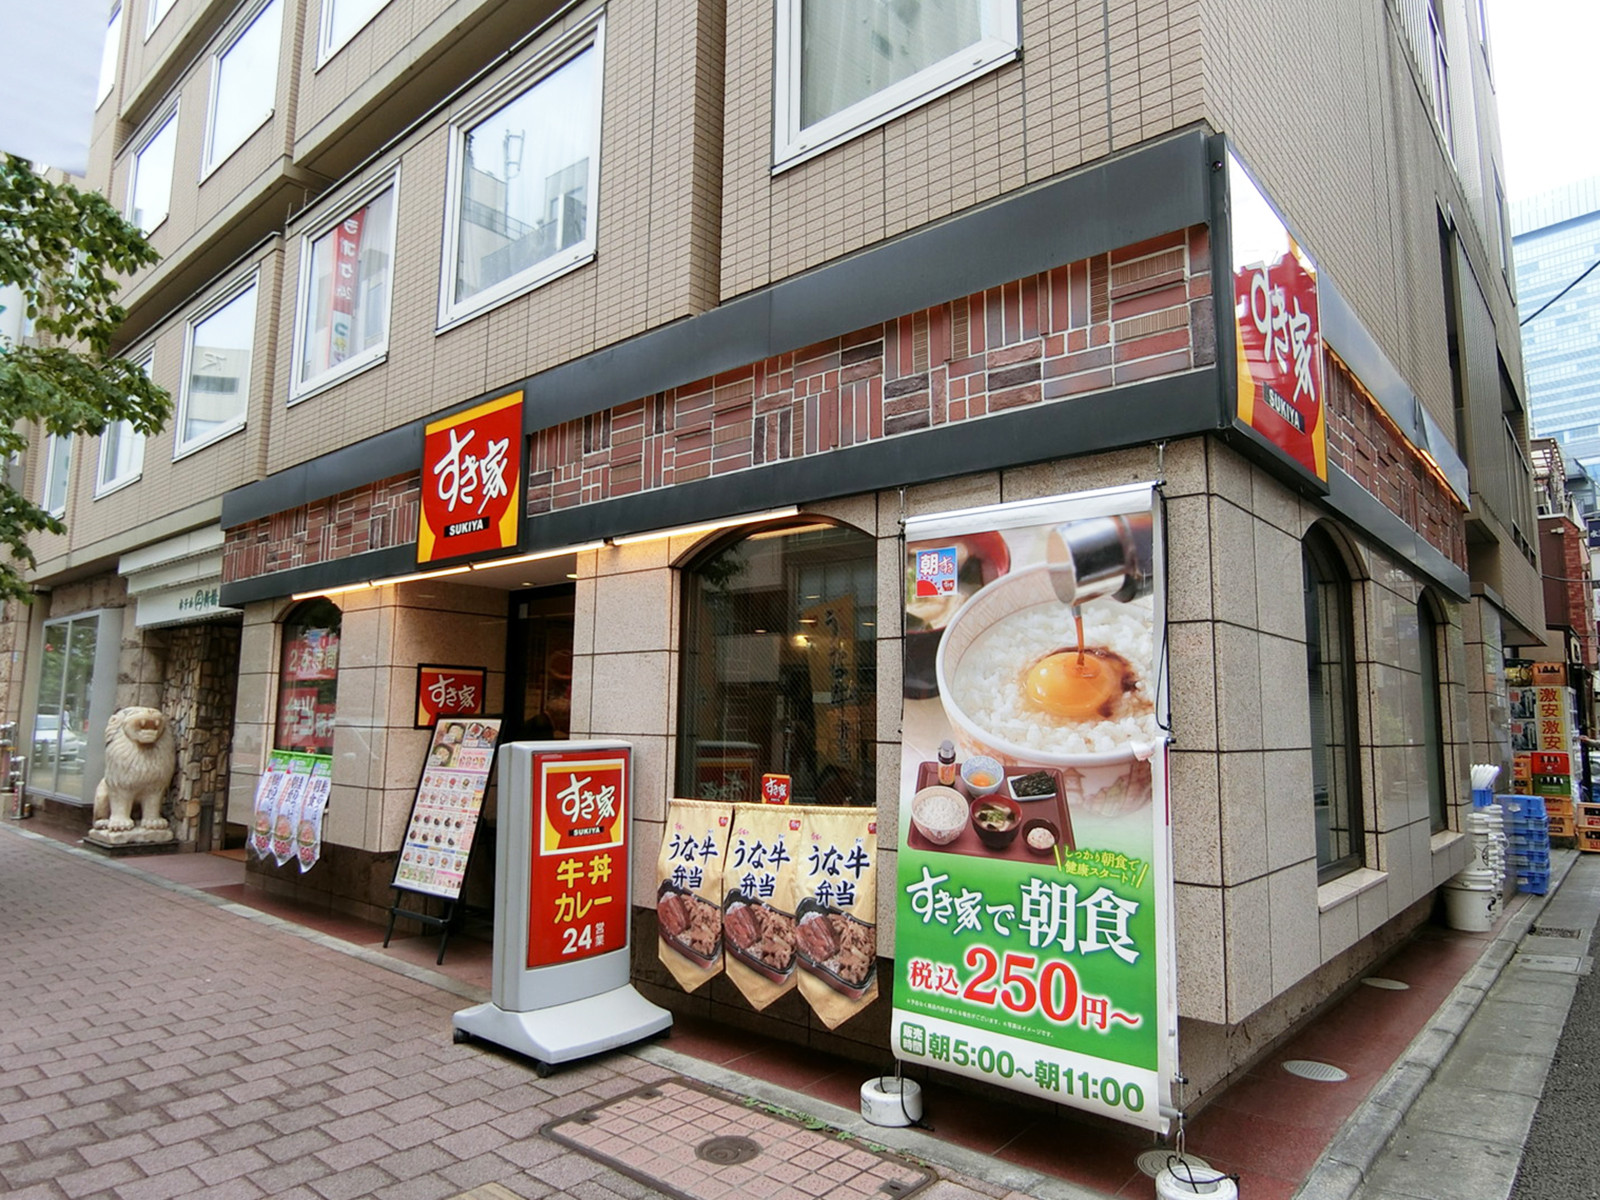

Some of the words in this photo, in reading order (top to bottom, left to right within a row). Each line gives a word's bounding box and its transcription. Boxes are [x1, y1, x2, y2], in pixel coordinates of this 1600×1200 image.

[1246, 261, 1315, 402] すき家
[1268, 388, 1301, 430] SUKIYA
[434, 429, 510, 514] すき家
[449, 519, 484, 537] SUKIYA
[428, 674, 475, 711] すき家
[1540, 688, 1558, 717] 激安
[1543, 720, 1561, 750] 激安
[556, 773, 615, 825] すき家
[765, 777, 787, 798] すき家
[573, 826, 600, 836] SUKIYA
[669, 834, 718, 864] うな牛
[734, 840, 790, 872] うな牛
[808, 845, 870, 879] うな牛
[1065, 845, 1140, 871] しっかり朝食で
[556, 853, 613, 889] 牛丼
[672, 865, 703, 889] 弁当
[740, 872, 775, 898] 弁当
[554, 891, 613, 924] カレー
[815, 880, 856, 907] 弁当
[906, 866, 1140, 964] すき家で朝食
[562, 924, 593, 954] 24
